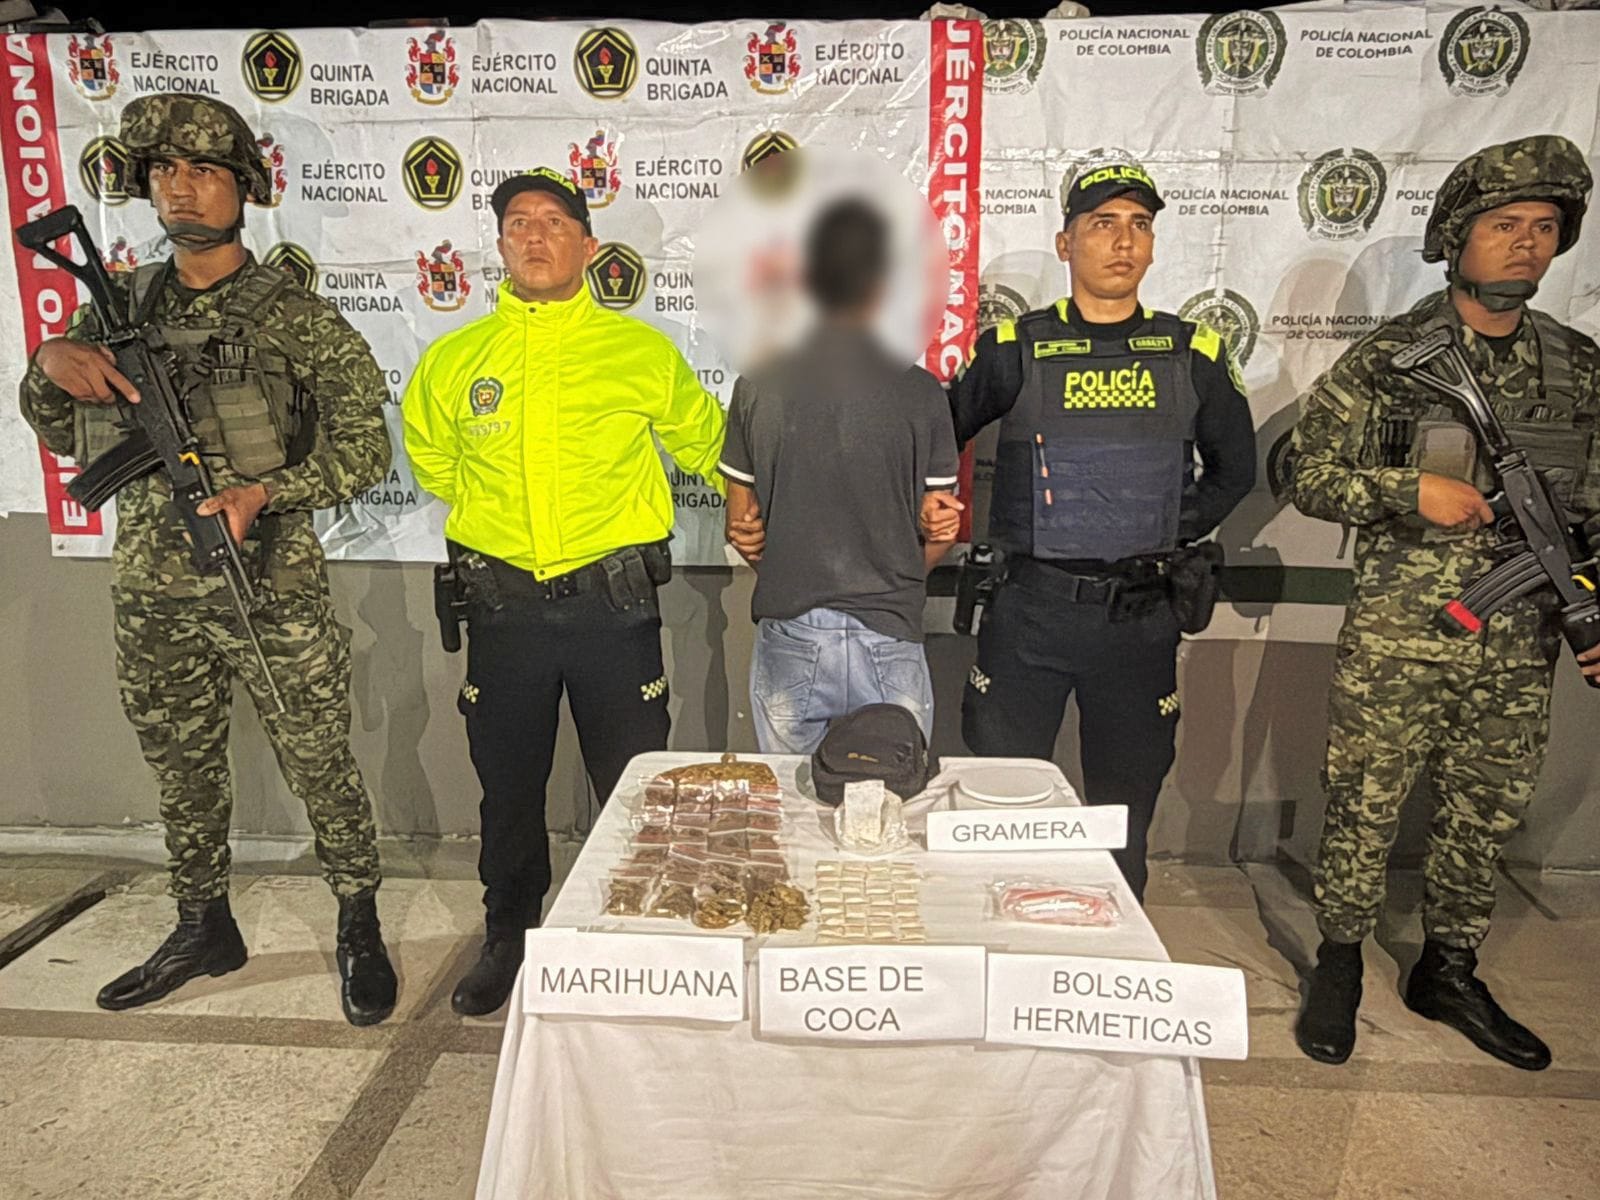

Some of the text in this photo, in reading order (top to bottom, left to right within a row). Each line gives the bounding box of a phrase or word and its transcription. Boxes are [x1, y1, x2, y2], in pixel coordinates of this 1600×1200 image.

[1059, 25, 1190, 41] POLICÍA NACIONAL
[1300, 27, 1434, 43] POLICÍA NACIONAL
[815, 39, 904, 61] EJÉRCITO
[1076, 44, 1171, 56] DE COLOMBIA
[1315, 45, 1413, 59] DE COLOMBIA
[131, 51, 218, 72] EJÉRCITO
[472, 52, 557, 72] EJÉRCITO
[646, 58, 712, 76] QUINTA
[310, 64, 374, 83] QUINTA
[816, 67, 903, 86] NACIONAL
[133, 76, 220, 95] NACIONAL
[472, 77, 558, 94] NACIONAL
[647, 82, 728, 101] BRIGADA
[310, 89, 390, 106] BRIGADA
[301, 161, 386, 180] EJÉRCITO
[635, 156, 723, 177] EJÉRCITO
[301, 186, 388, 203] NACIONAL
[635, 183, 720, 199] NACIONAL
[985, 188, 1054, 200] NACIONAL
[1163, 186, 1289, 201] POLICÍA NACIONAL
[1178, 204, 1270, 216] DE COLOMBIA
[1411, 205, 1429, 216] DE
[325, 273, 387, 290] QUINTA
[655, 295, 697, 312] BRIG
[1272, 312, 1322, 327] POLICÍA
[1285, 329, 1304, 340] DE
[1065, 361, 1154, 391] POLICÍA
[952, 820, 1087, 842] GRAMERA
[541, 966, 738, 998] MARIHUANA
[779, 966, 924, 992] BASE DE
[1053, 970, 1174, 1003] BOLSAS
[804, 1007, 900, 1032] COCA
[1013, 1006, 1213, 1046] HERMETICAS
